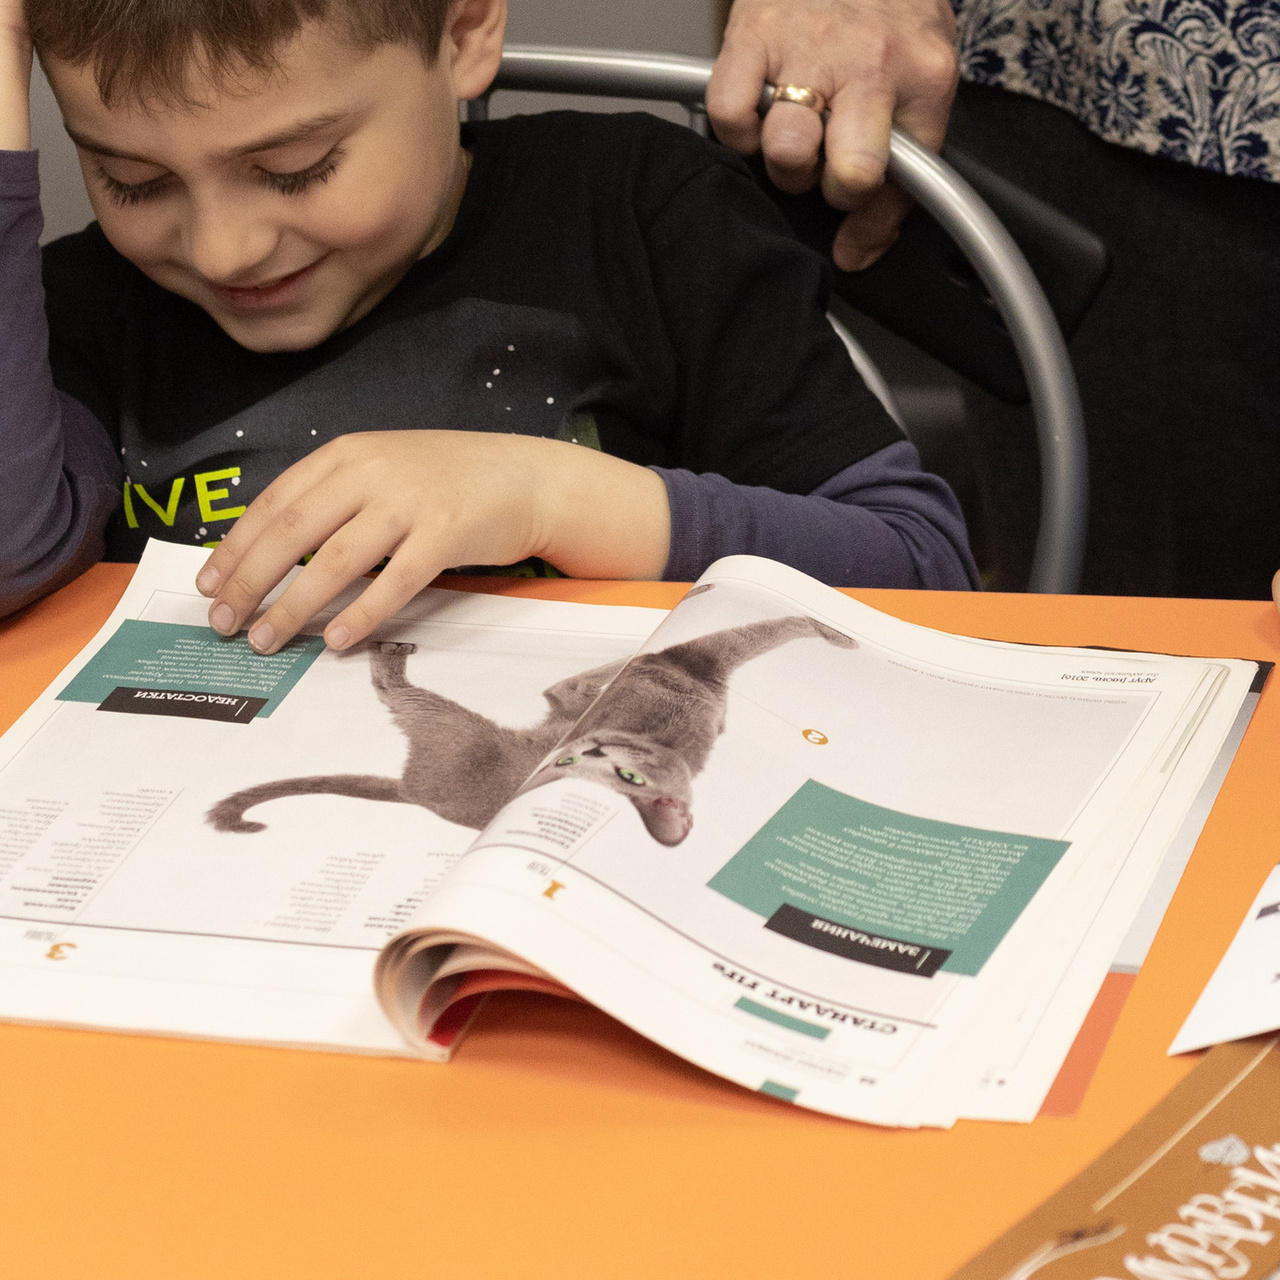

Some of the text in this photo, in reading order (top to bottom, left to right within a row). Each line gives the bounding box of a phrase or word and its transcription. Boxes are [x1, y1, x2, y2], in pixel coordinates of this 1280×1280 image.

[133, 690, 238, 706] НЕДОСТАТКИ
[808, 731, 824, 743] 2
[543, 880, 566, 901] 1
[810, 918, 921, 957] ЗАМЕЧАНИЯ
[45, 942, 78, 961] 3
[764, 989, 898, 1035] СТАНДАРТ
